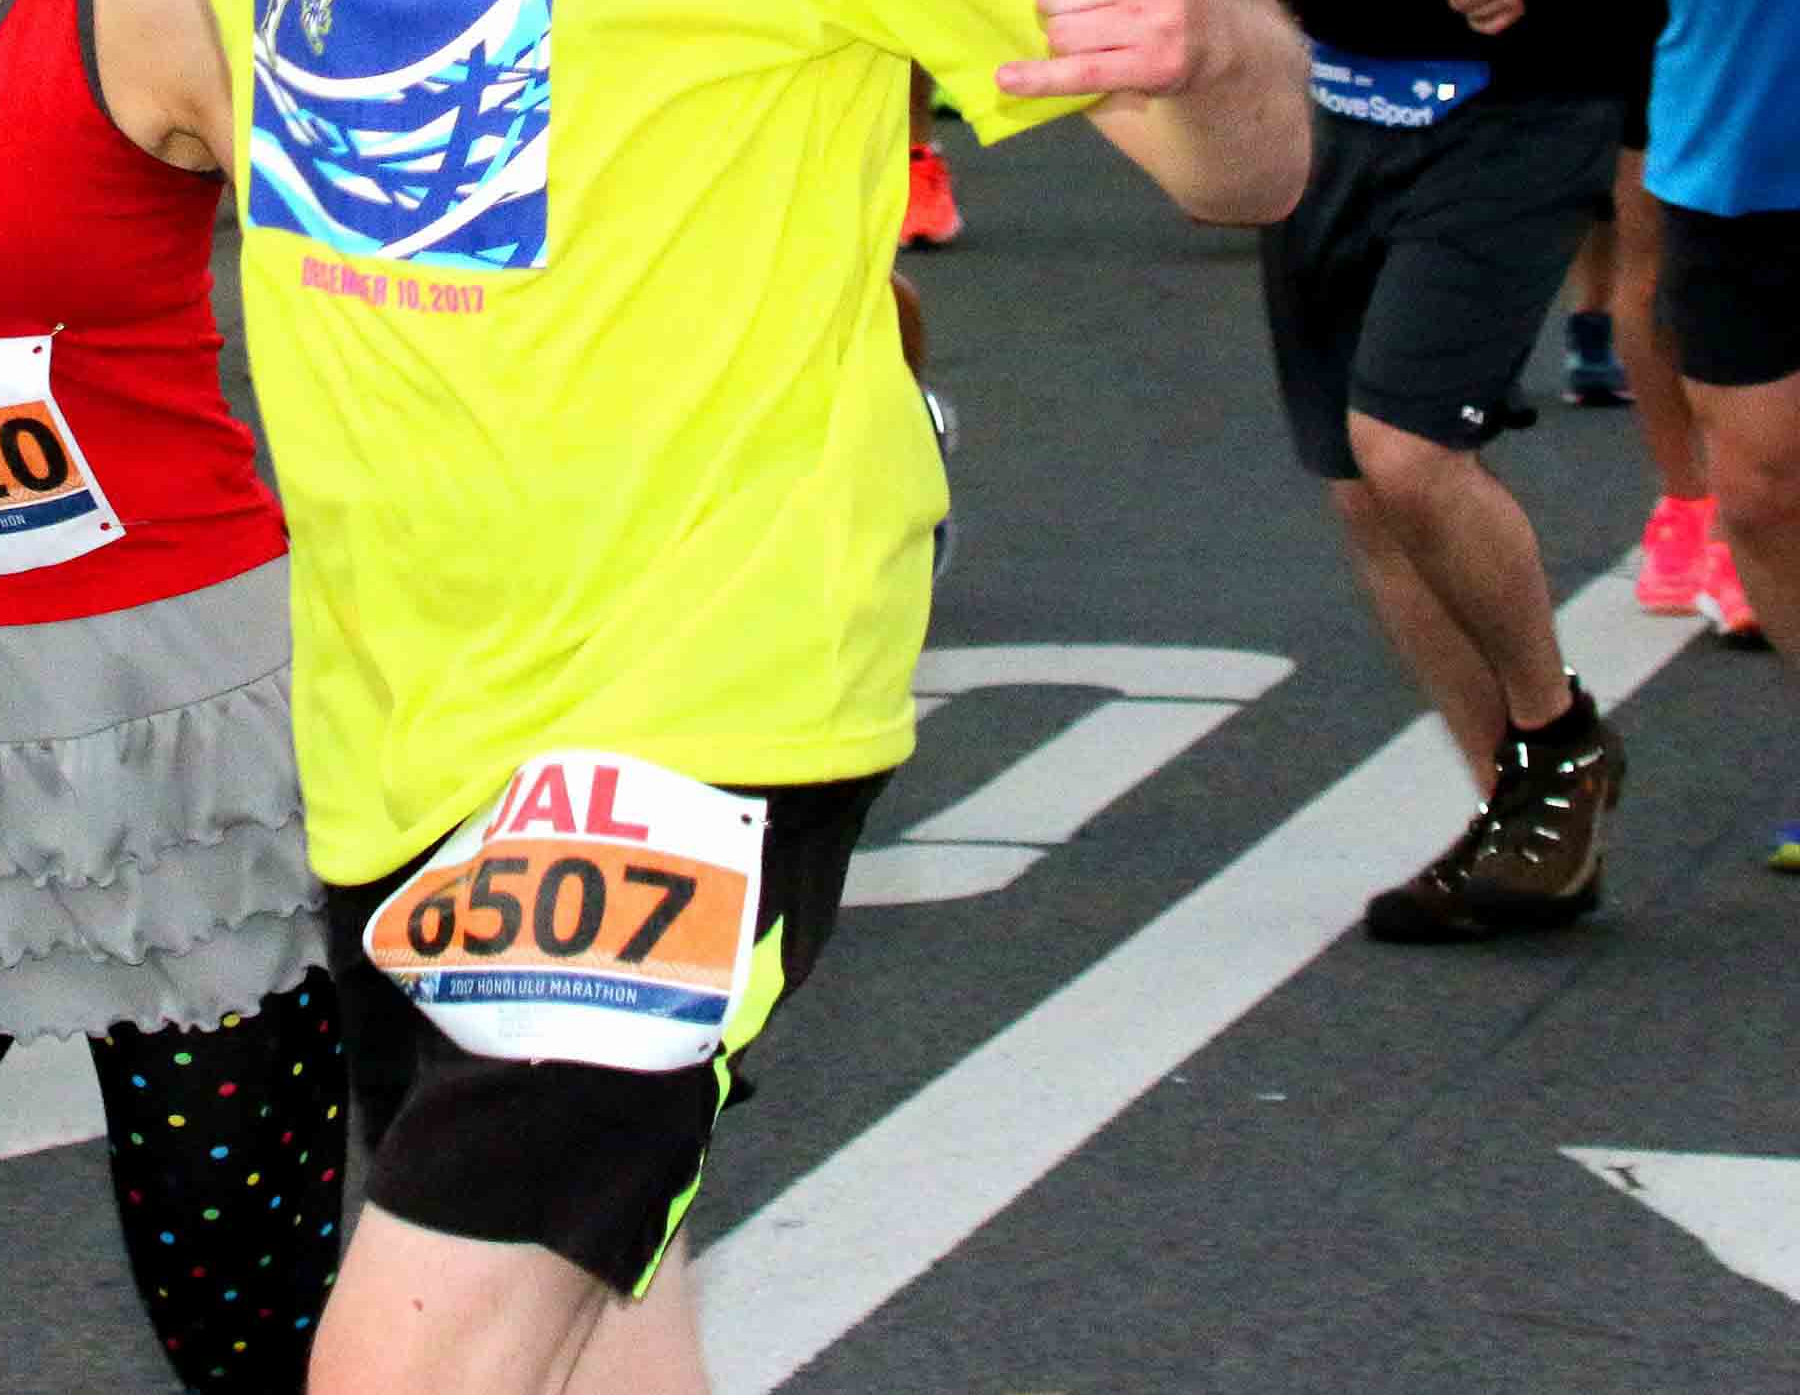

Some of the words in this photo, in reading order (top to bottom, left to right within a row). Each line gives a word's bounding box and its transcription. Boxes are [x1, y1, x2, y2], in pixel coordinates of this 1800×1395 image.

[483, 764, 650, 842] JAL
[477, 979, 545, 996] HONOLULU
[549, 979, 638, 1004] MARATHON
